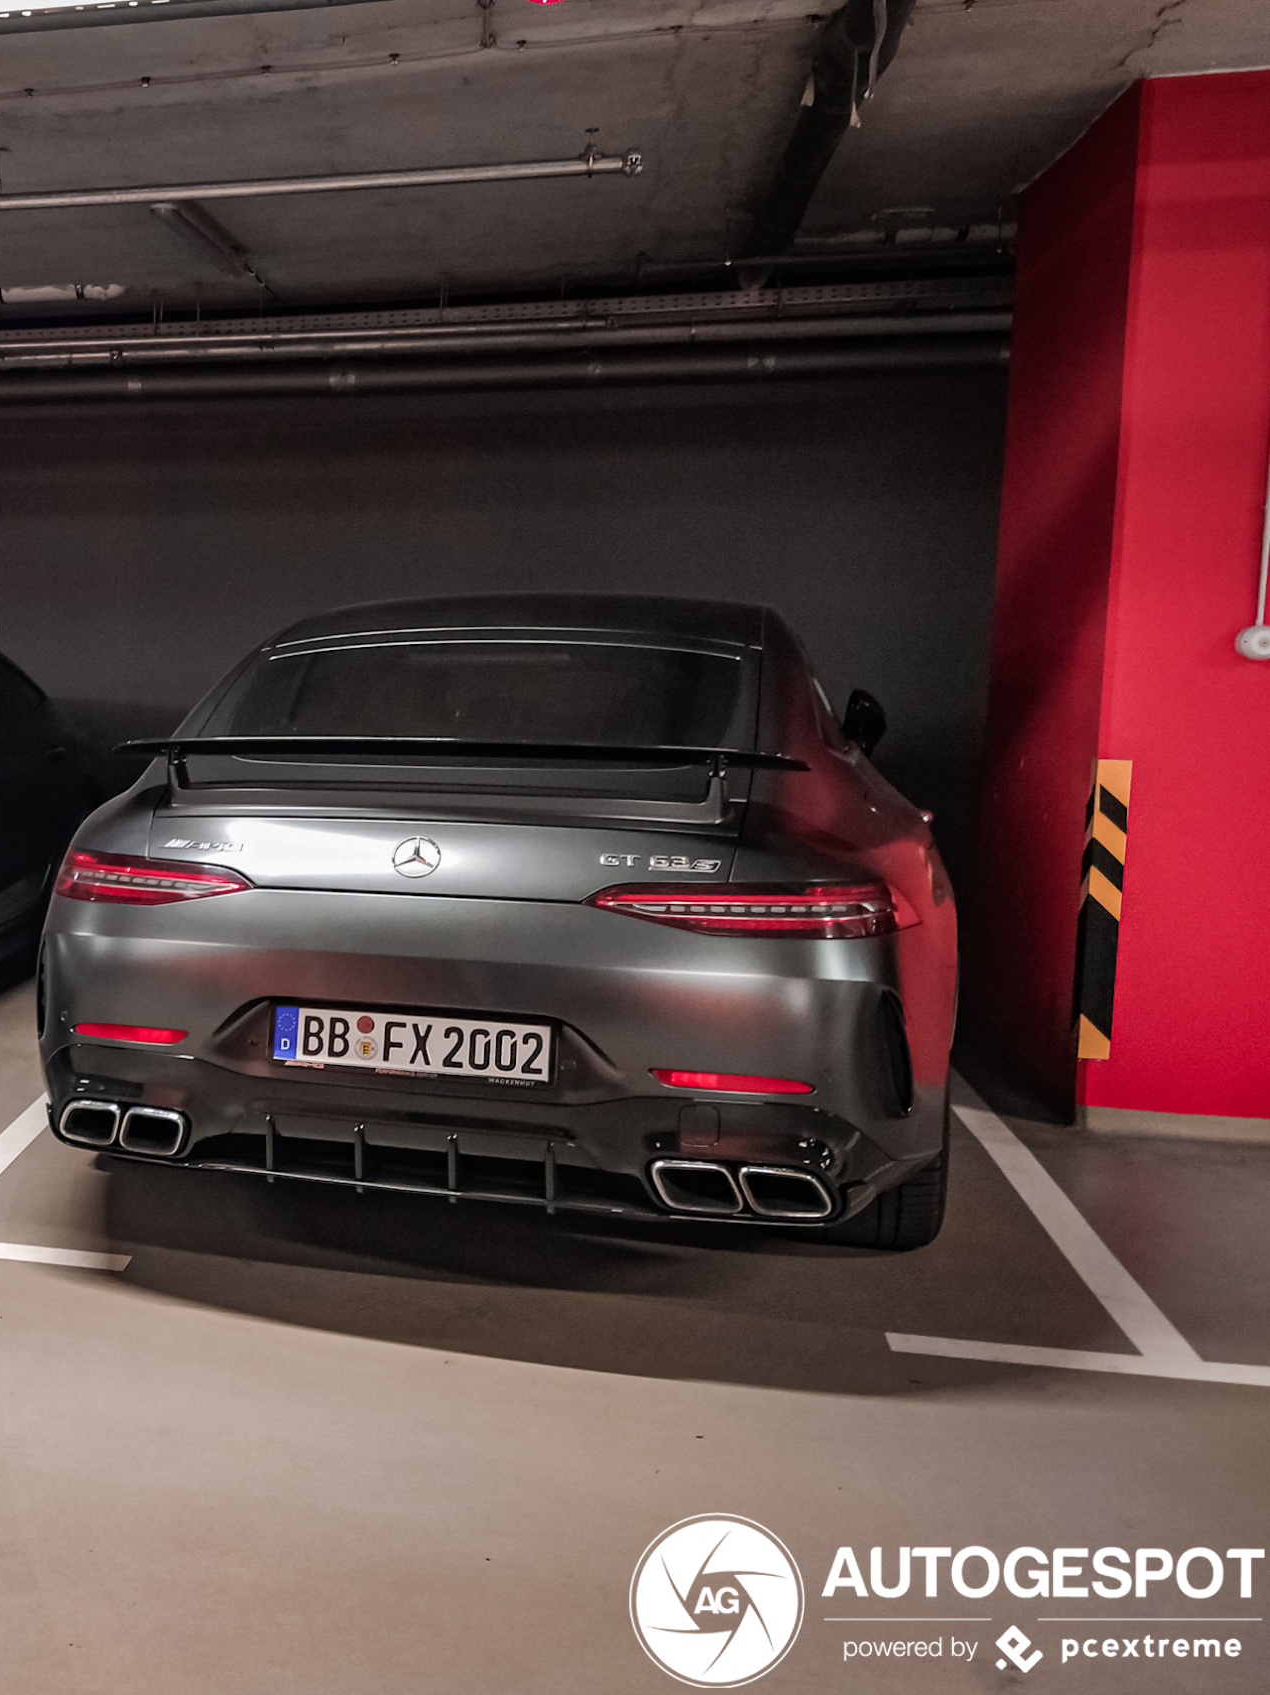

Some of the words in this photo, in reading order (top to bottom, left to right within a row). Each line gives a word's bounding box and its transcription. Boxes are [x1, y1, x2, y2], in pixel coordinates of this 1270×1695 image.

[599, 852, 642, 867] GT
[280, 1037, 291, 1051] D
[302, 1015, 350, 1057] BB
[382, 1021, 433, 1066] FX
[442, 1026, 544, 1075] 2002
[488, 1077, 536, 1087] WACKENHUT
